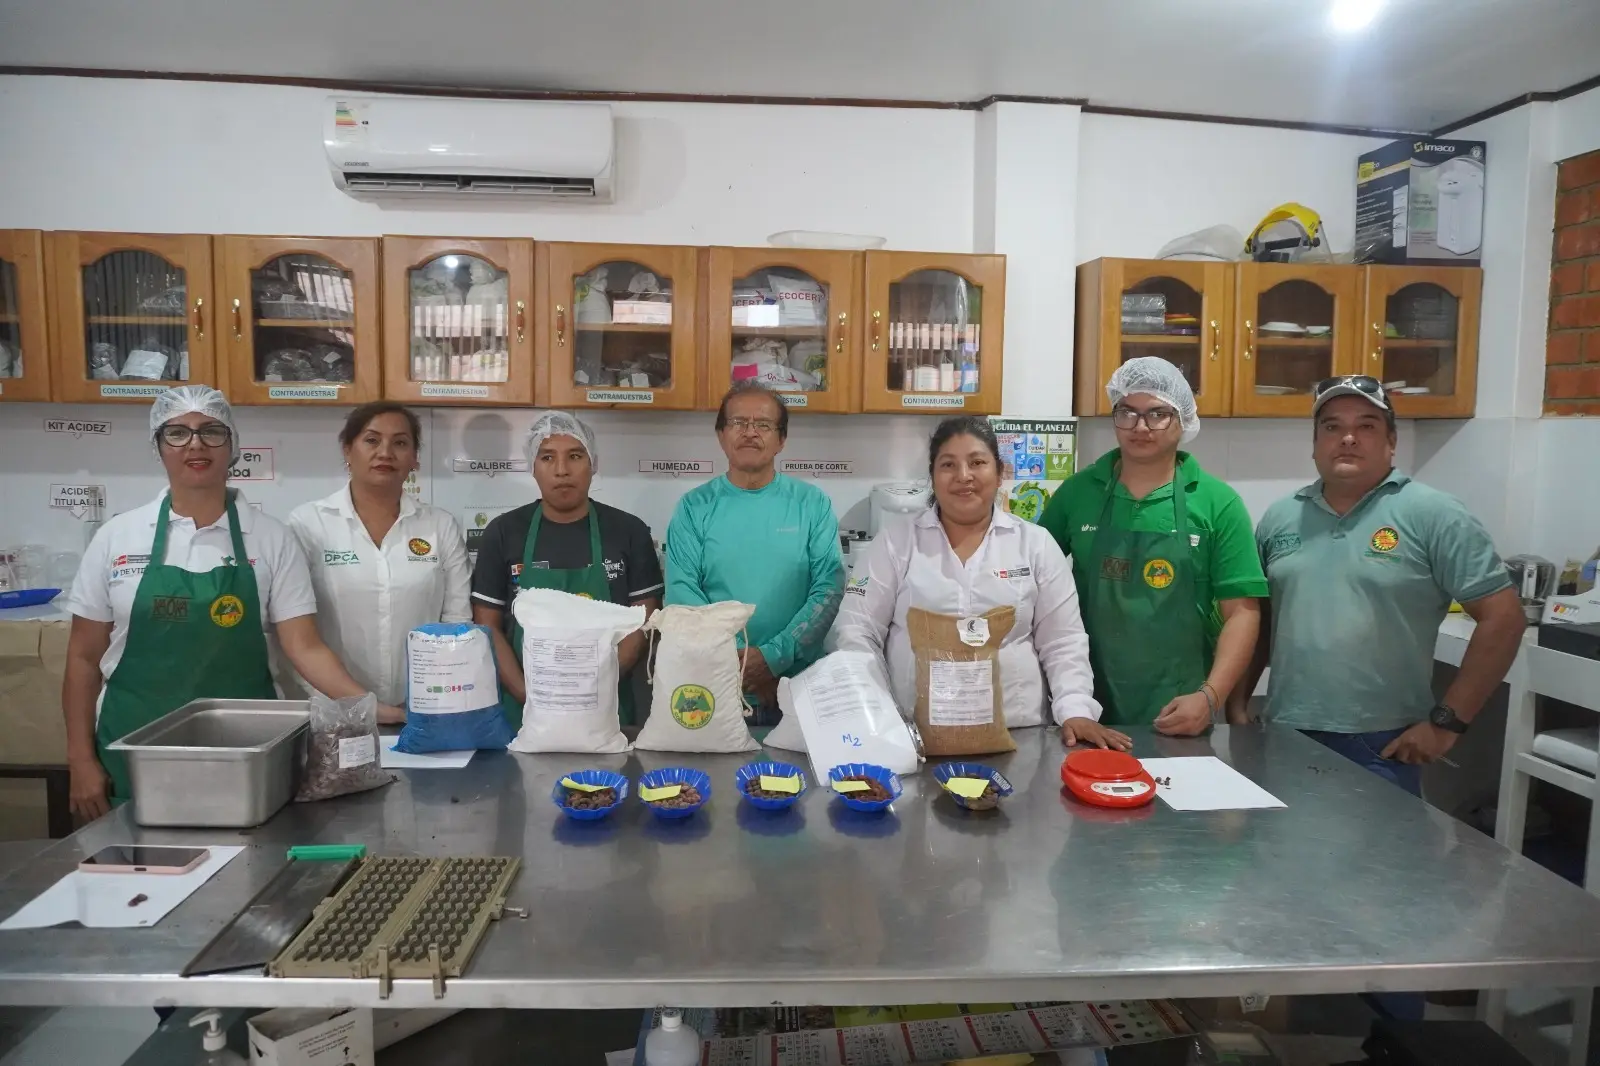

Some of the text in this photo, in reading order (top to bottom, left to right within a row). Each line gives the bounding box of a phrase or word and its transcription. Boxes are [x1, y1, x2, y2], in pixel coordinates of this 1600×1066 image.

[1424, 143, 1455, 153] imaco
[270, 389, 336, 397] CONTRAMUESTRAS
[422, 387, 487, 396] CONTRAMUESTRAS
[588, 392, 652, 401] CONTRAMUESTRAS
[903, 397, 963, 405] CONTRAMUESTRAS
[48, 421, 107, 433] KIT ACIDEZ
[1023, 423, 1034, 432] EL
[1035, 423, 1074, 432] PLANETA!
[243, 452, 262, 462] en
[469, 461, 512, 470] CALIBRE
[652, 462, 701, 471] HUMEDAD
[60, 487, 91, 496] ACIDE
[324, 553, 359, 563] DPCA
